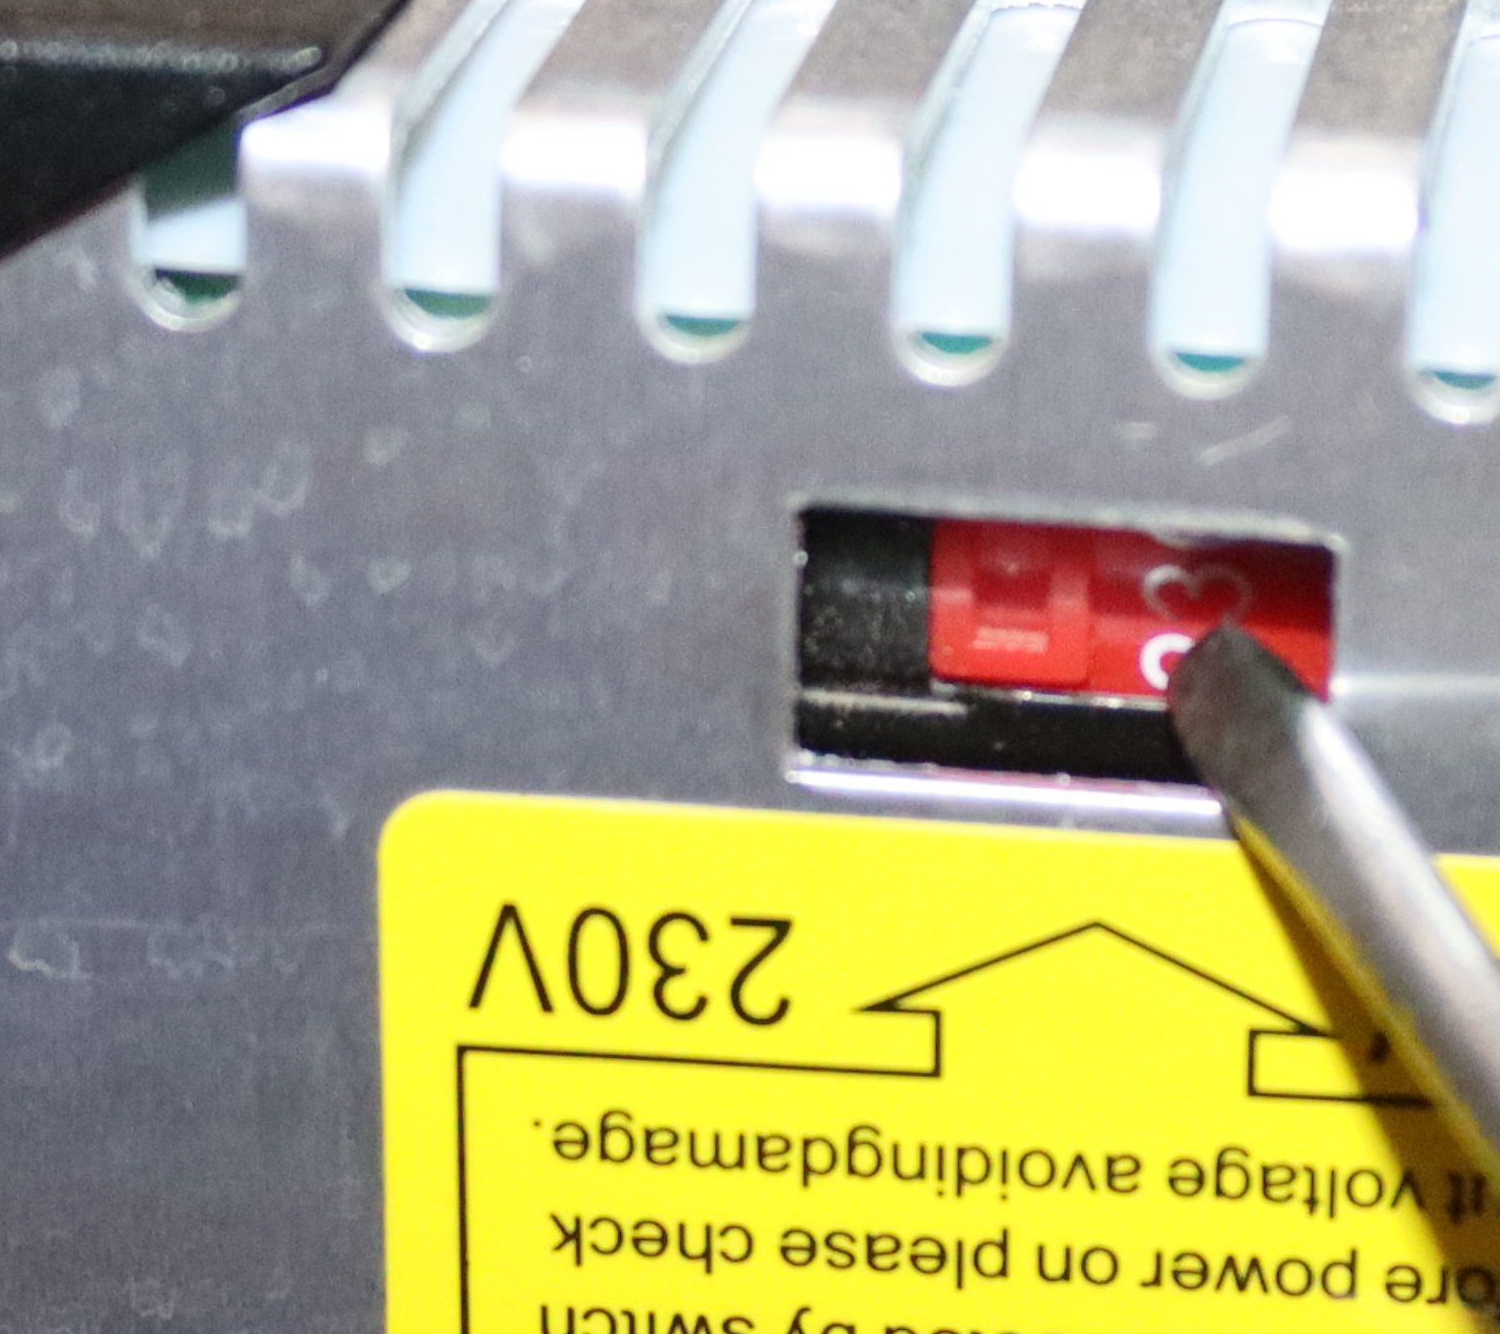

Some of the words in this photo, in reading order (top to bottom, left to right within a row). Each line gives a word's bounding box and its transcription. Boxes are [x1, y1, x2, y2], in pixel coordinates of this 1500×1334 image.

[468, 903, 793, 1026] 230V
[528, 1112, 1141, 1200] avoidingdamage.
[1168, 1147, 1421, 1220] voltage
[550, 1215, 754, 1274] check
[779, 1228, 1009, 1289] please
[1037, 1245, 1119, 1286] on
[1139, 1249, 1358, 1300] power
